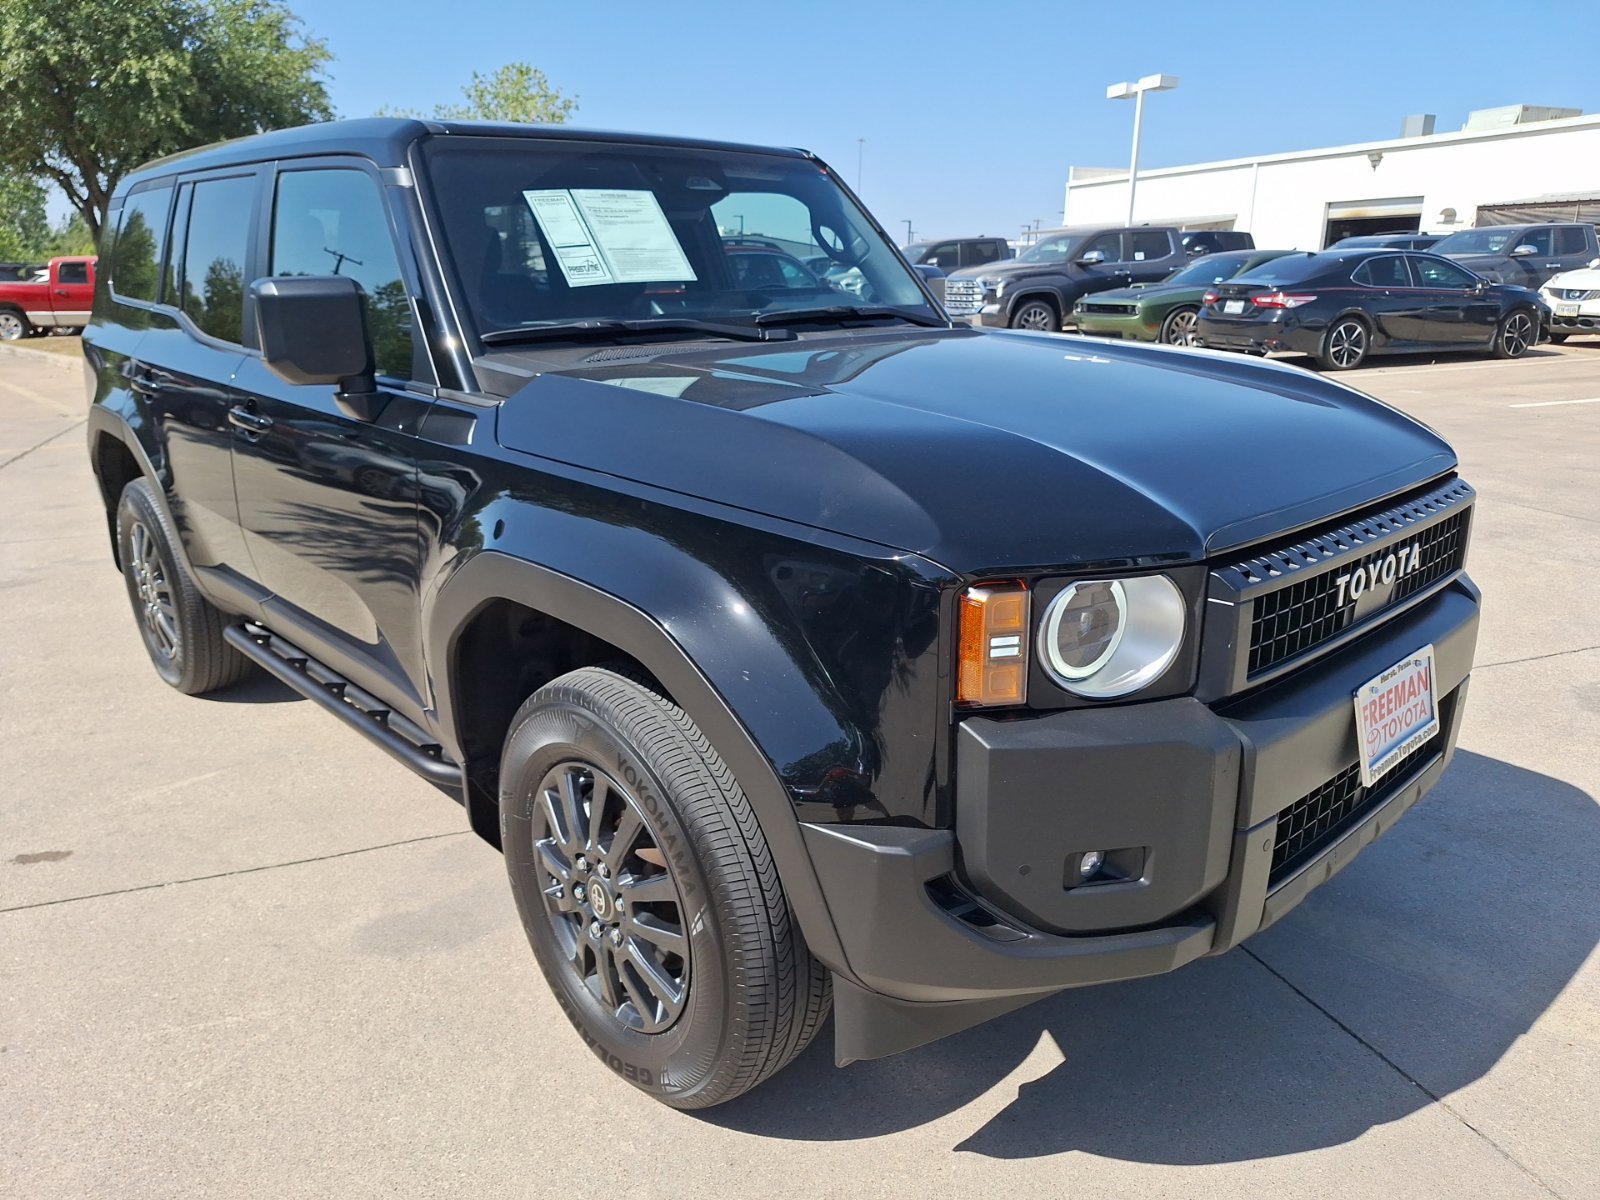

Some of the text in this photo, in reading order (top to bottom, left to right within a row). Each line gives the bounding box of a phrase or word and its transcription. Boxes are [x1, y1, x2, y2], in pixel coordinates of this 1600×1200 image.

[1336, 542, 1420, 607] TOYOTA
[1362, 666, 1429, 732] FREEMAN
[1382, 699, 1428, 743] TOYOTA
[1369, 723, 1438, 782] FreemanToyota.com
[616, 752, 697, 898] YOKOHAMA
